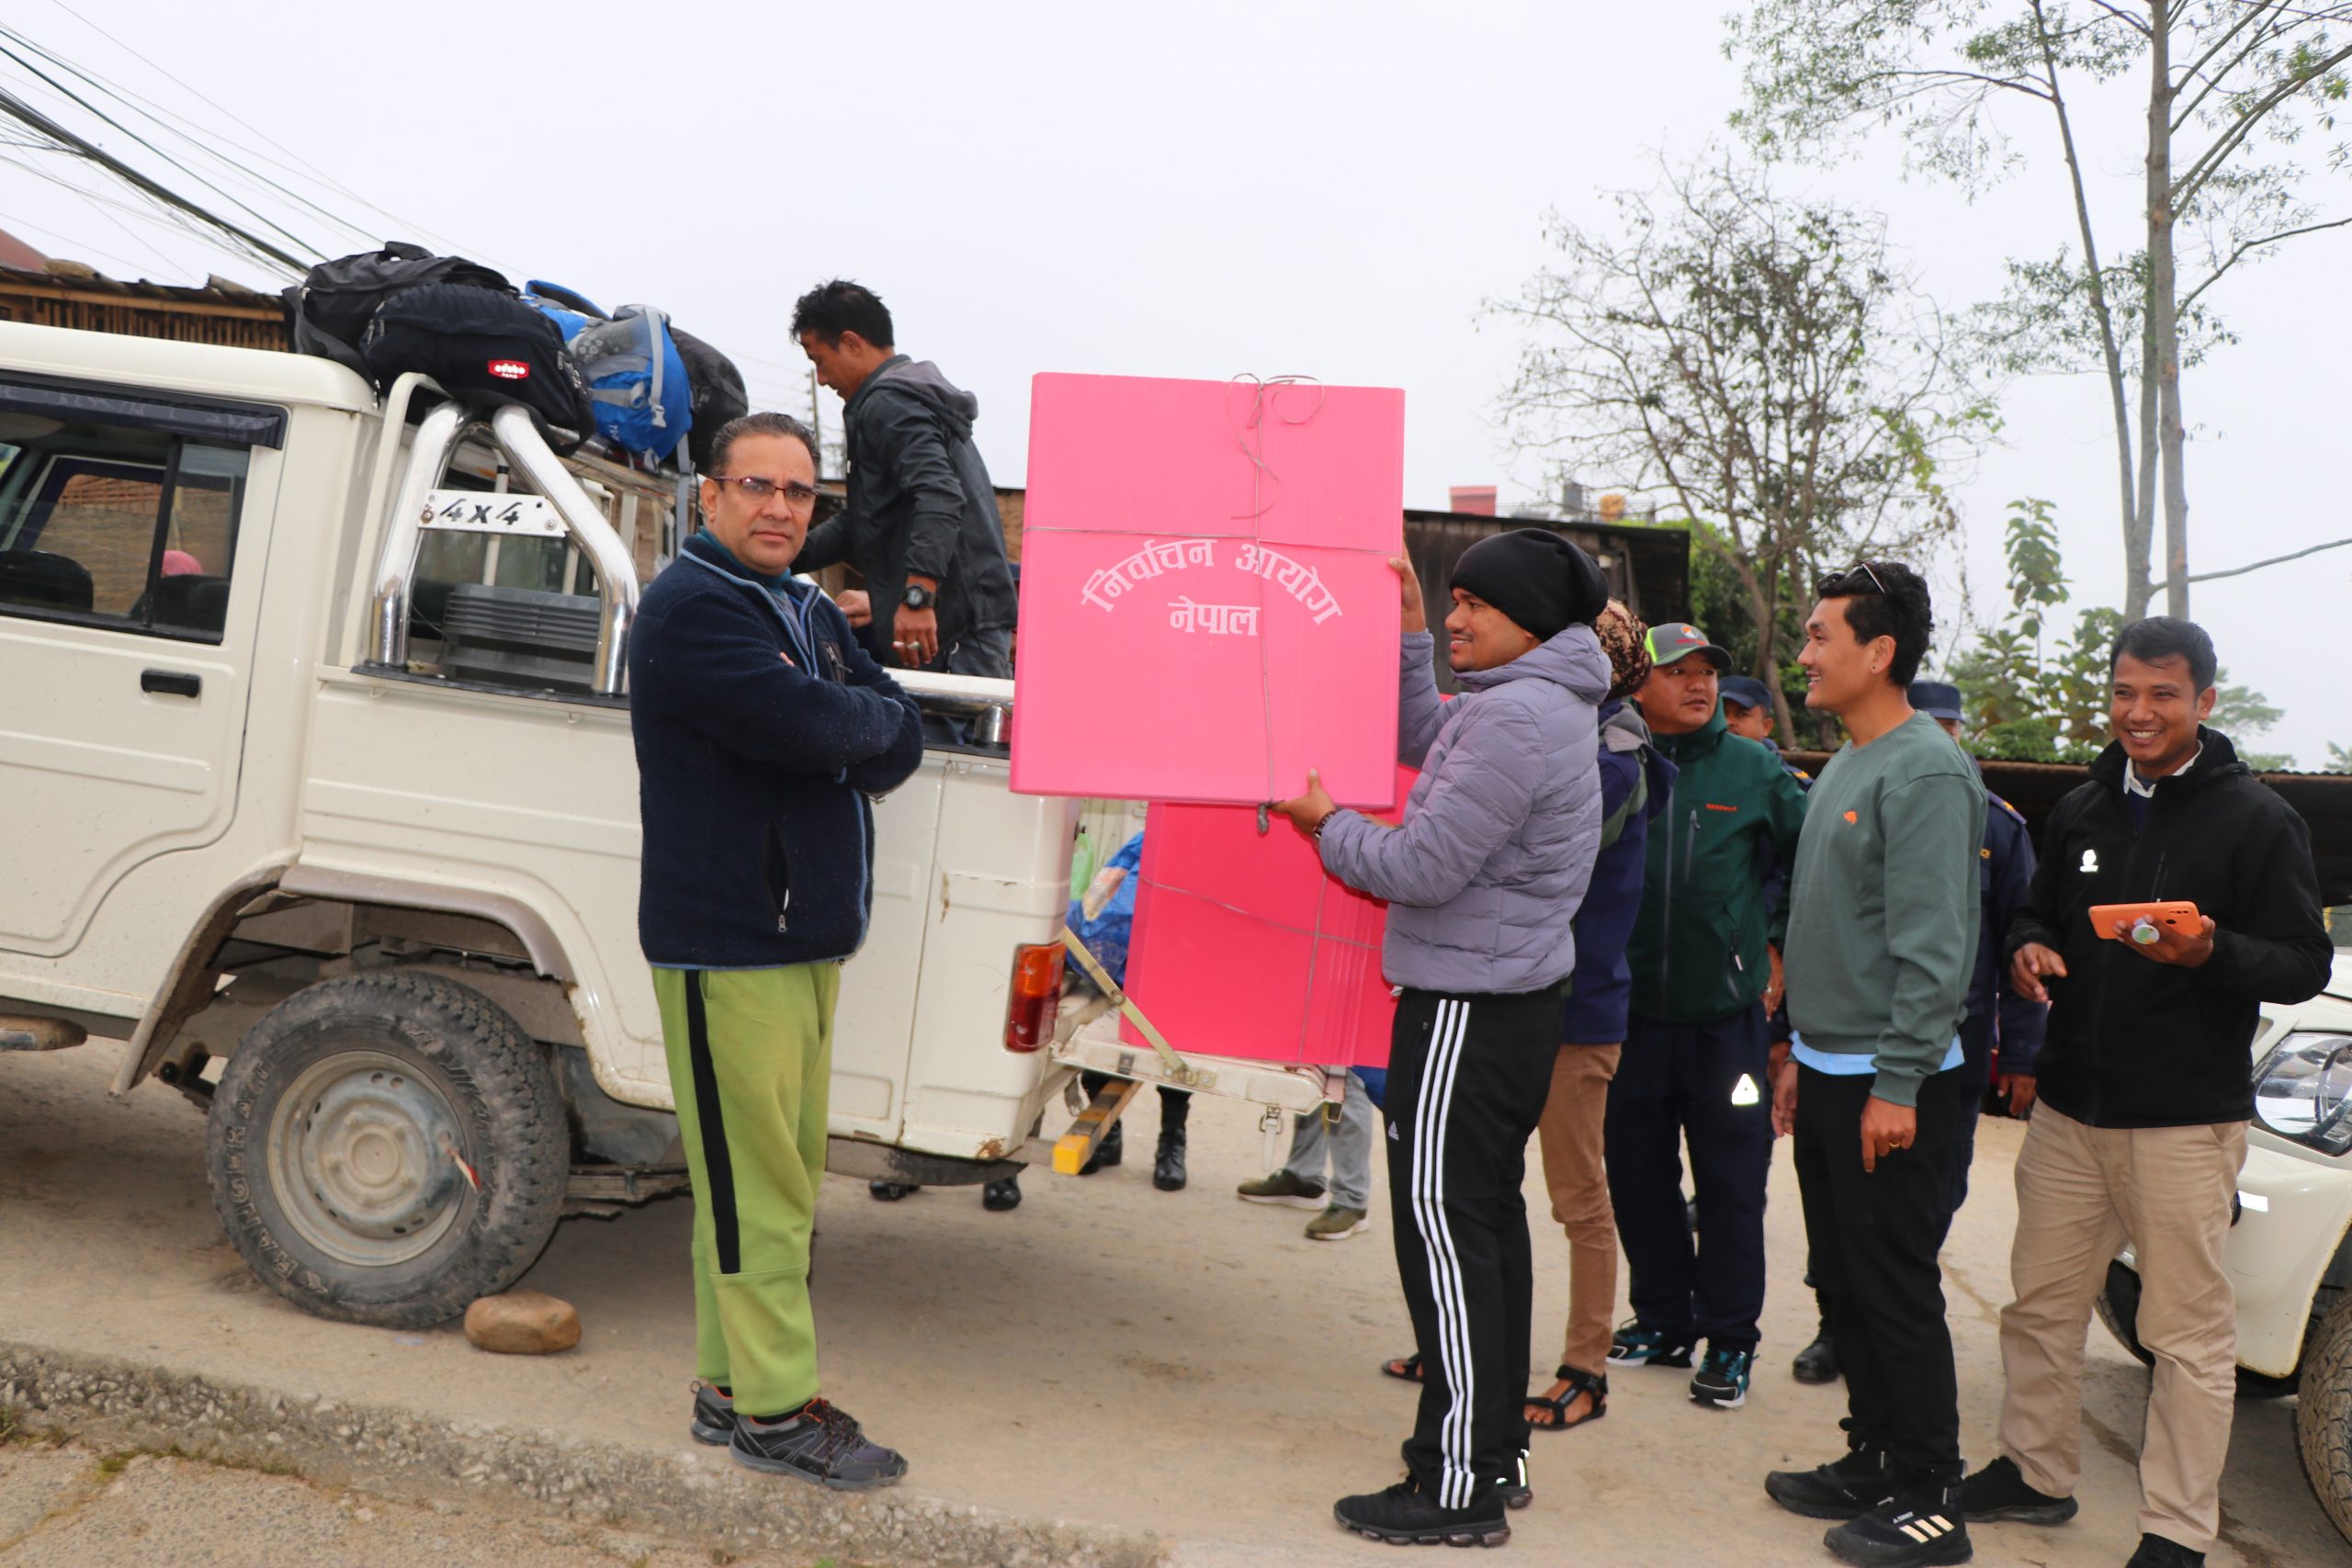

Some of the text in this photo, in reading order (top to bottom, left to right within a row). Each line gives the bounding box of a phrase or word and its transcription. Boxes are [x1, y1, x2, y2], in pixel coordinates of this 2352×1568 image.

[1080, 538, 1343, 625] निर्वाचन आयोग
[1167, 595, 1261, 636] नेपाल
[225, 1125, 300, 1280] RANGER
